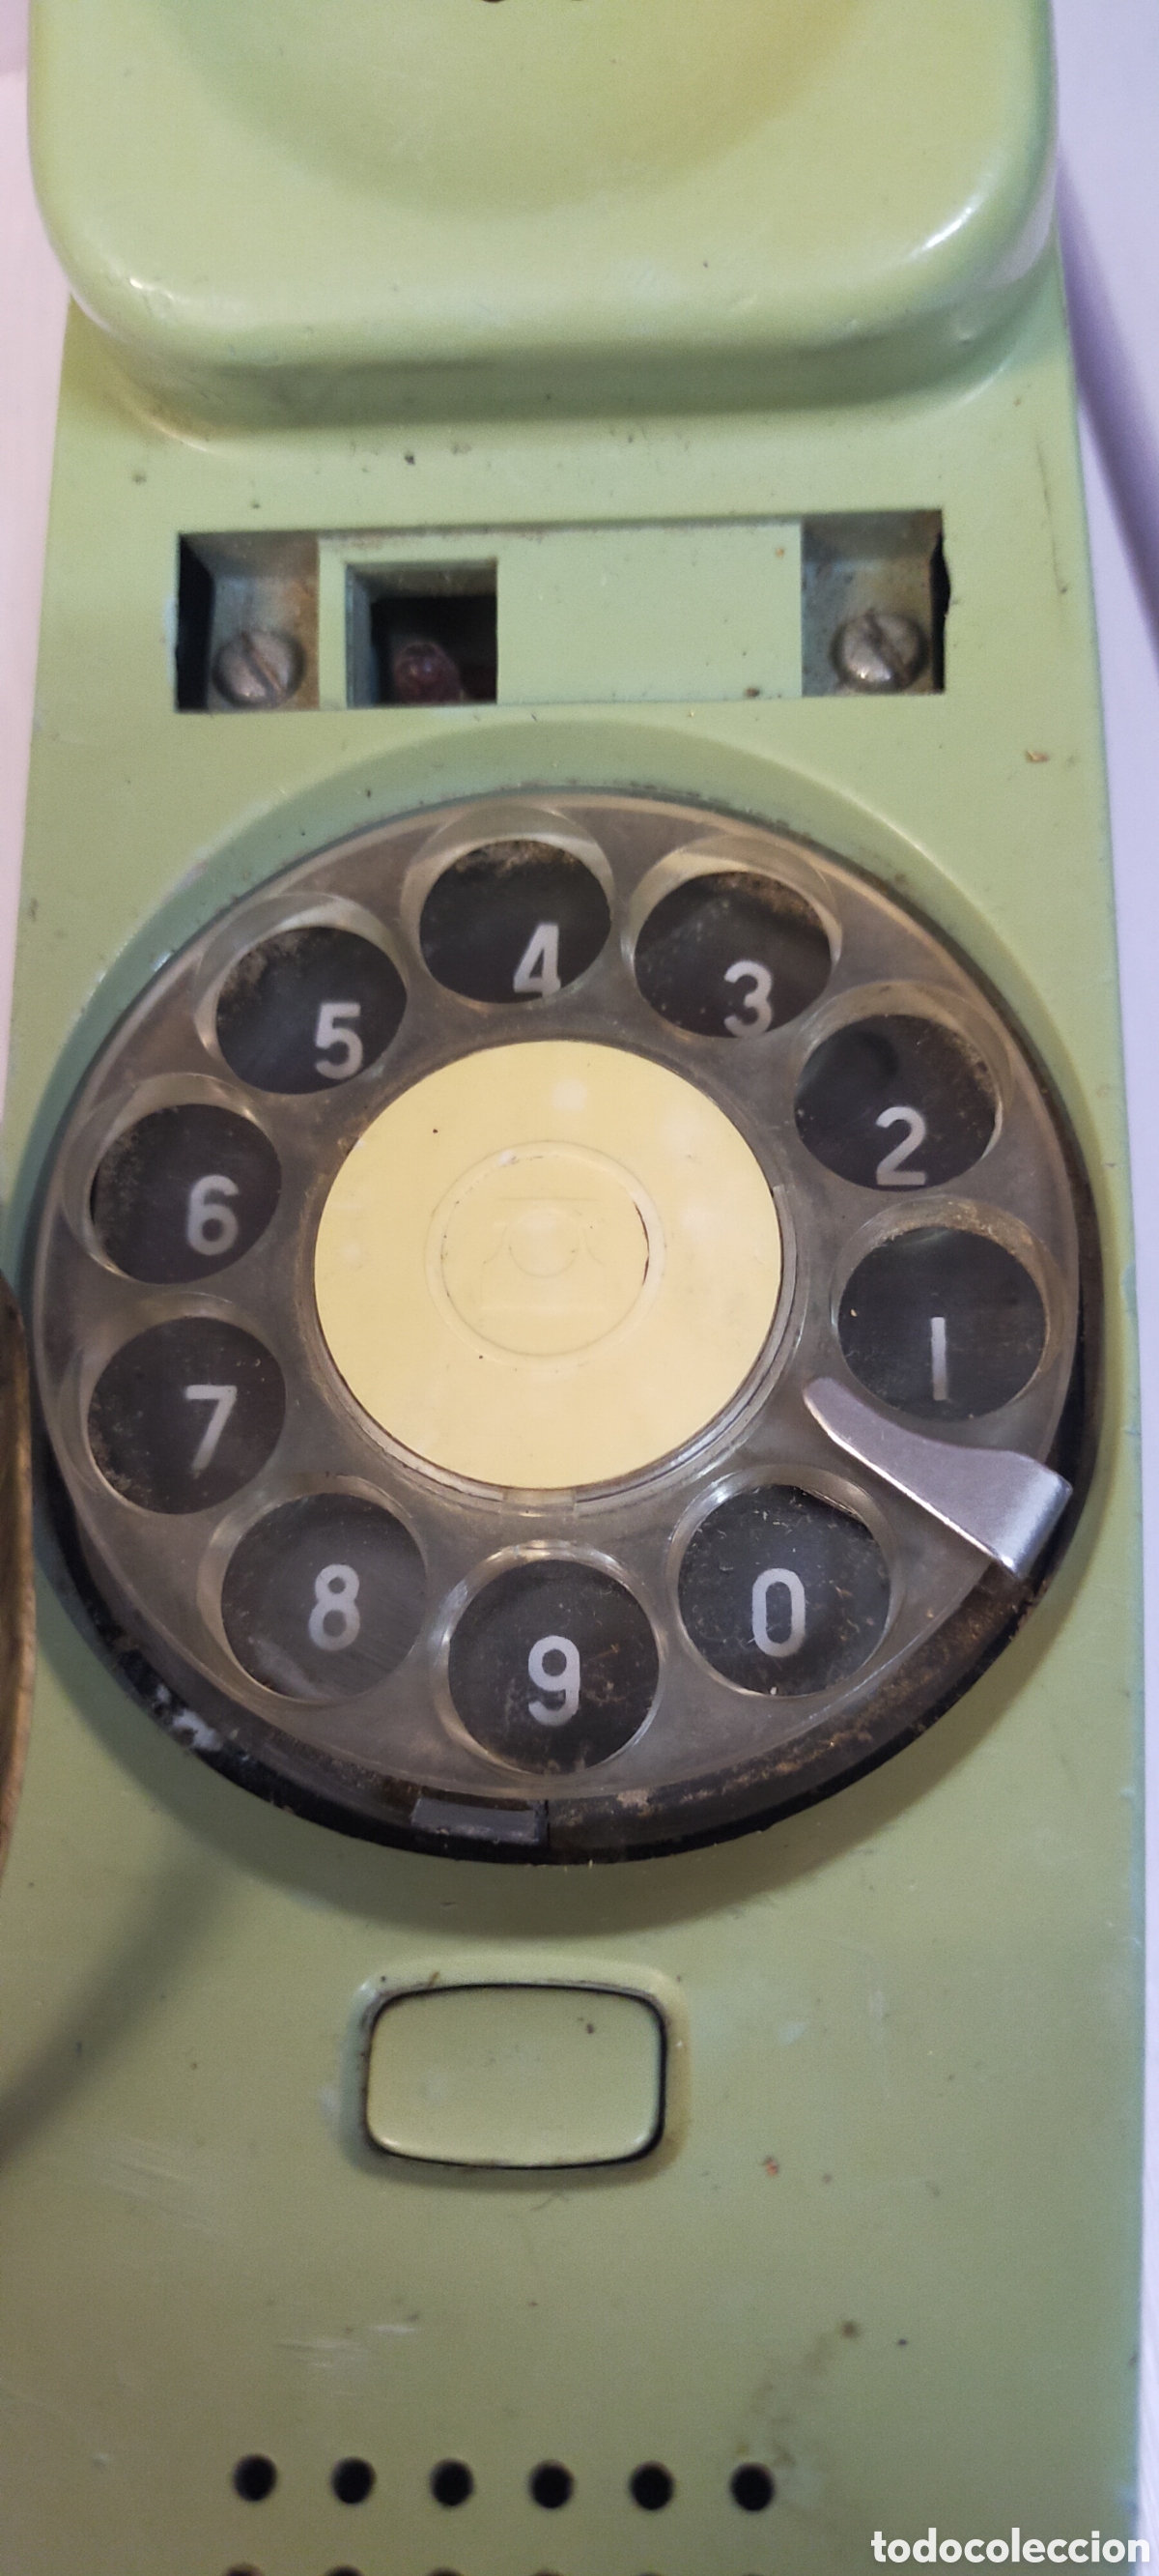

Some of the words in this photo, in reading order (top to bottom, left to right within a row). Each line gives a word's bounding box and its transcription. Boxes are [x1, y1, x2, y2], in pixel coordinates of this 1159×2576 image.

[512, 923, 561, 996] 4
[722, 960, 772, 1038] 3
[314, 1003, 363, 1079] 5
[874, 1106, 927, 1185] 2
[187, 1174, 239, 1256] 6
[930, 1316, 948, 1400] 1
[184, 1385, 238, 1477] 7
[309, 1564, 360, 1651] 8
[750, 1567, 805, 1657] 0
[526, 1636, 580, 1724] 9
